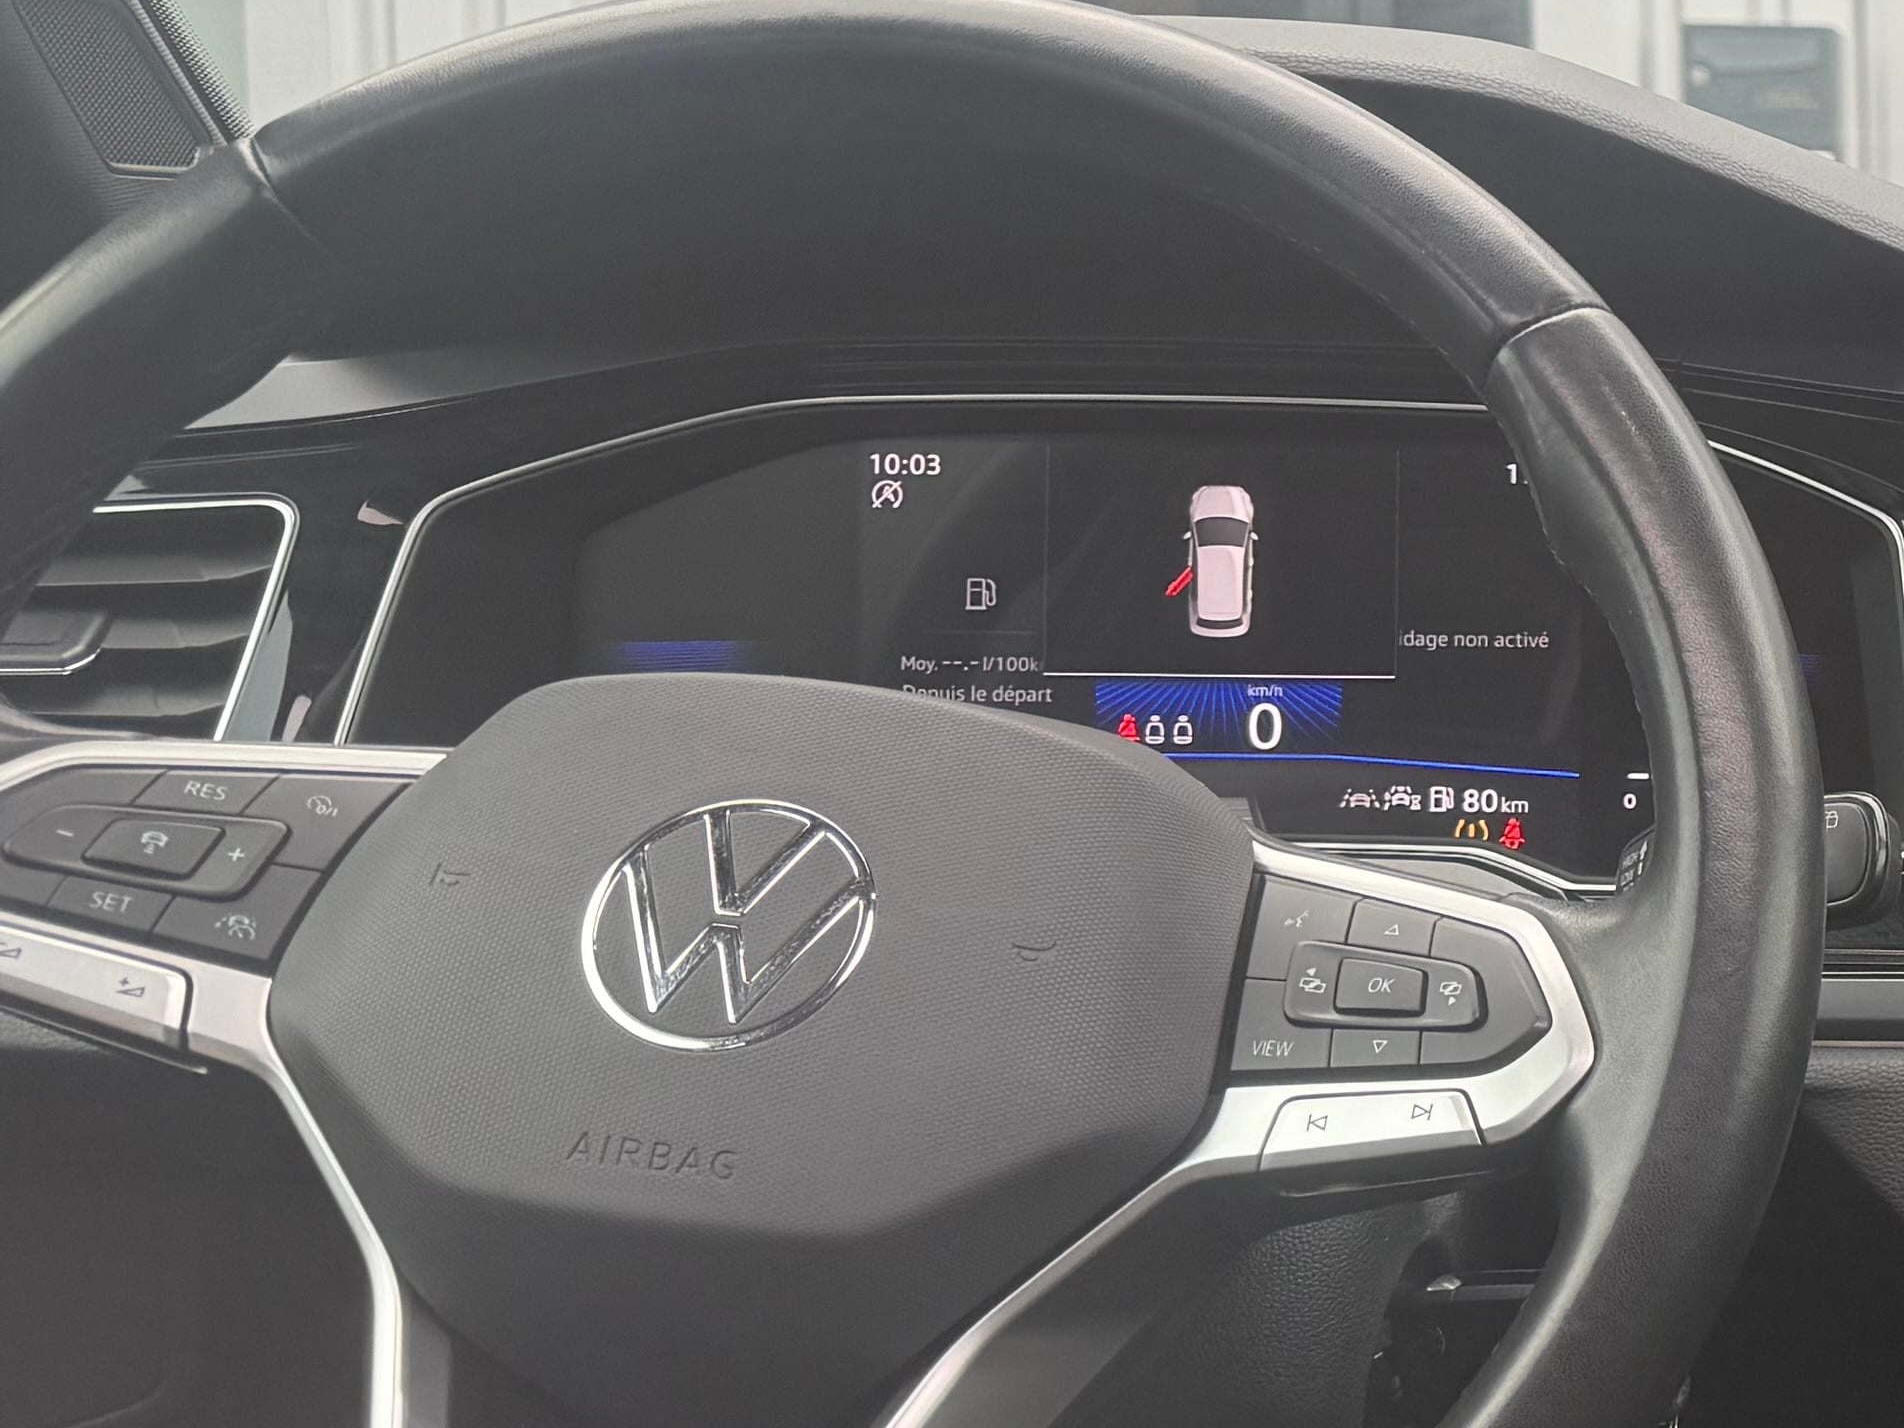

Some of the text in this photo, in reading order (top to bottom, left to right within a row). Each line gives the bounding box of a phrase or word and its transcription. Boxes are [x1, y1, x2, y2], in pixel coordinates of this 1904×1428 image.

[869, 452, 942, 477] 10:03
[1453, 634, 1489, 648] non
[1494, 631, 1550, 649] activé
[900, 655, 939, 675] Moy.
[971, 684, 987, 702] le
[991, 684, 1053, 707] départ
[1248, 701, 1283, 751] 0
[184, 780, 228, 802] RES
[1462, 788, 1530, 814] 80 km
[1623, 792, 1637, 810] 0
[89, 891, 134, 913] SET
[1368, 977, 1394, 993] OK
[1252, 1040, 1294, 1056] VIEW
[565, 1130, 738, 1180] AIRBAG
